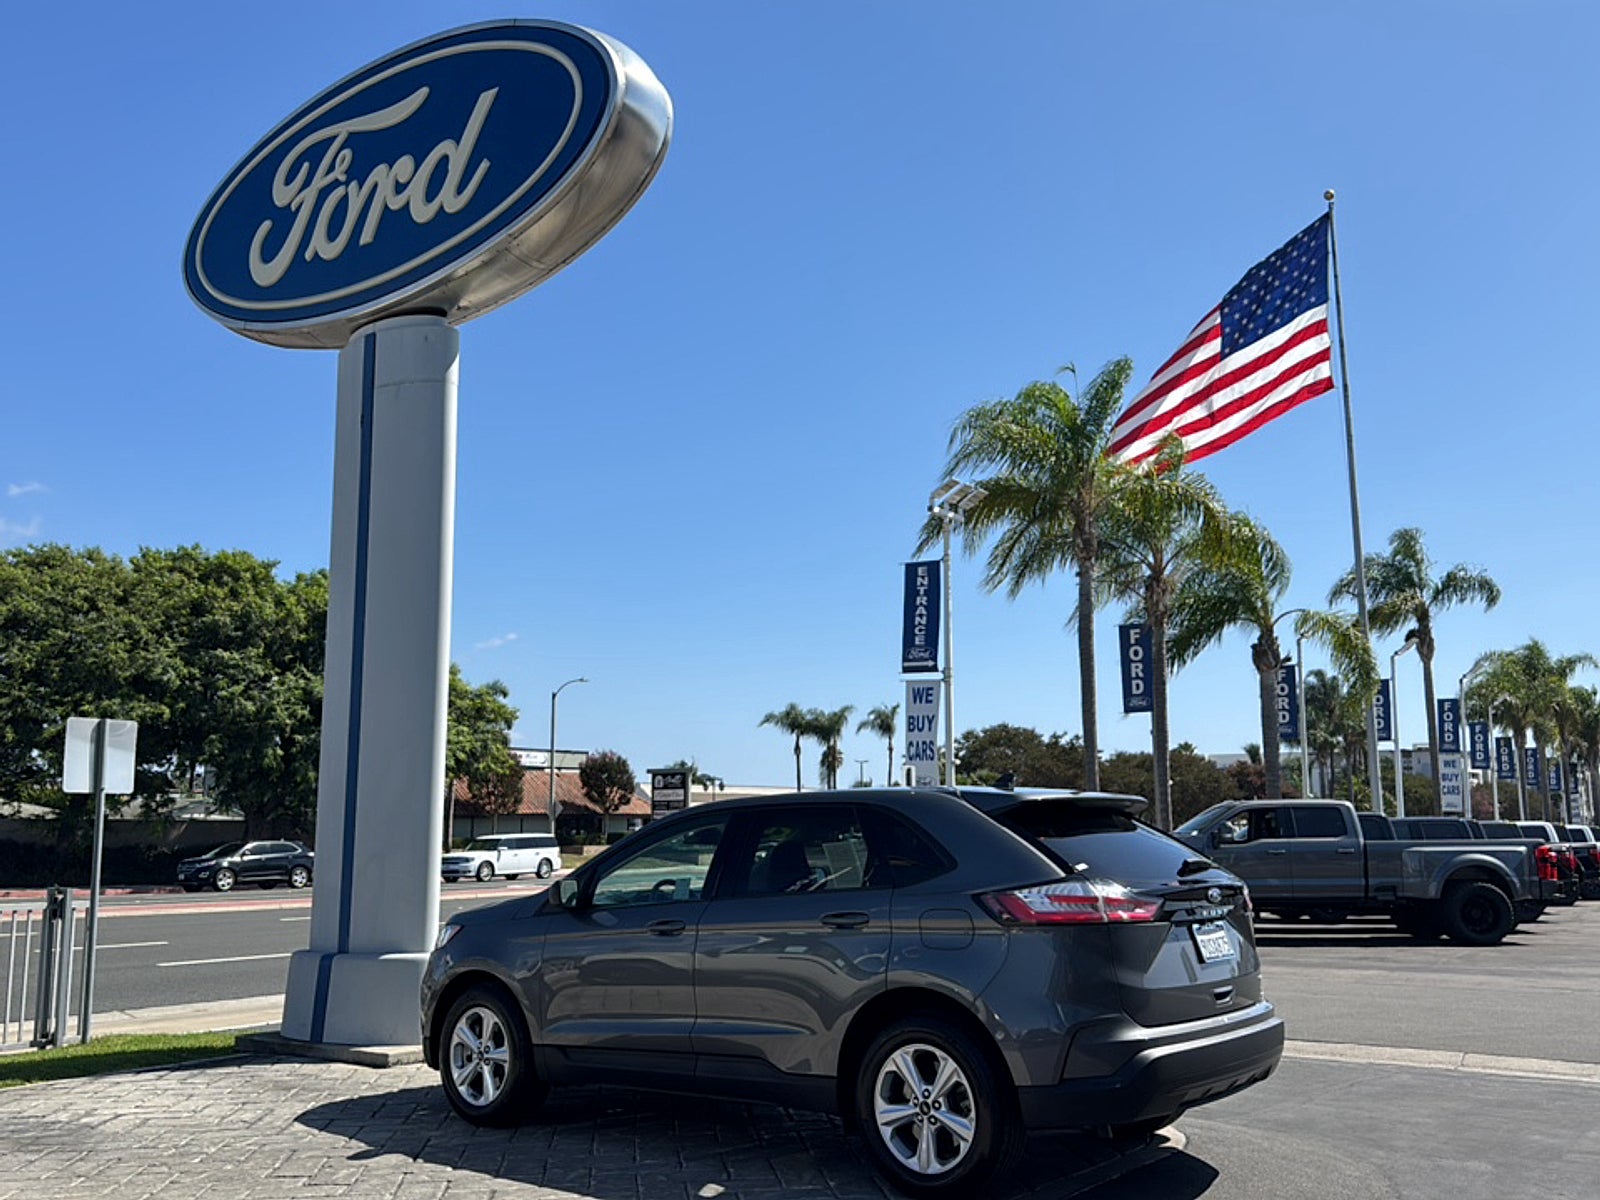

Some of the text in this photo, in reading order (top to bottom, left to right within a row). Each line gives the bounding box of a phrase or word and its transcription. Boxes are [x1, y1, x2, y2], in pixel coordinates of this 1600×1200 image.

[248, 86, 499, 288] Ford
[914, 566, 929, 645] ENTRANCE
[1129, 628, 1145, 695] FORD
[911, 687, 934, 704] WE
[1277, 669, 1290, 724] FORD
[1374, 684, 1385, 730] ORD
[908, 715, 935, 733] BUY
[1443, 701, 1454, 742] FORD
[907, 740, 935, 761] CARS
[1475, 724, 1485, 760] FORD
[1500, 739, 1510, 771] FORD
[1442, 773, 1459, 782] BUY
[1443, 760, 1456, 768] WE
[1442, 785, 1460, 796] CARS
